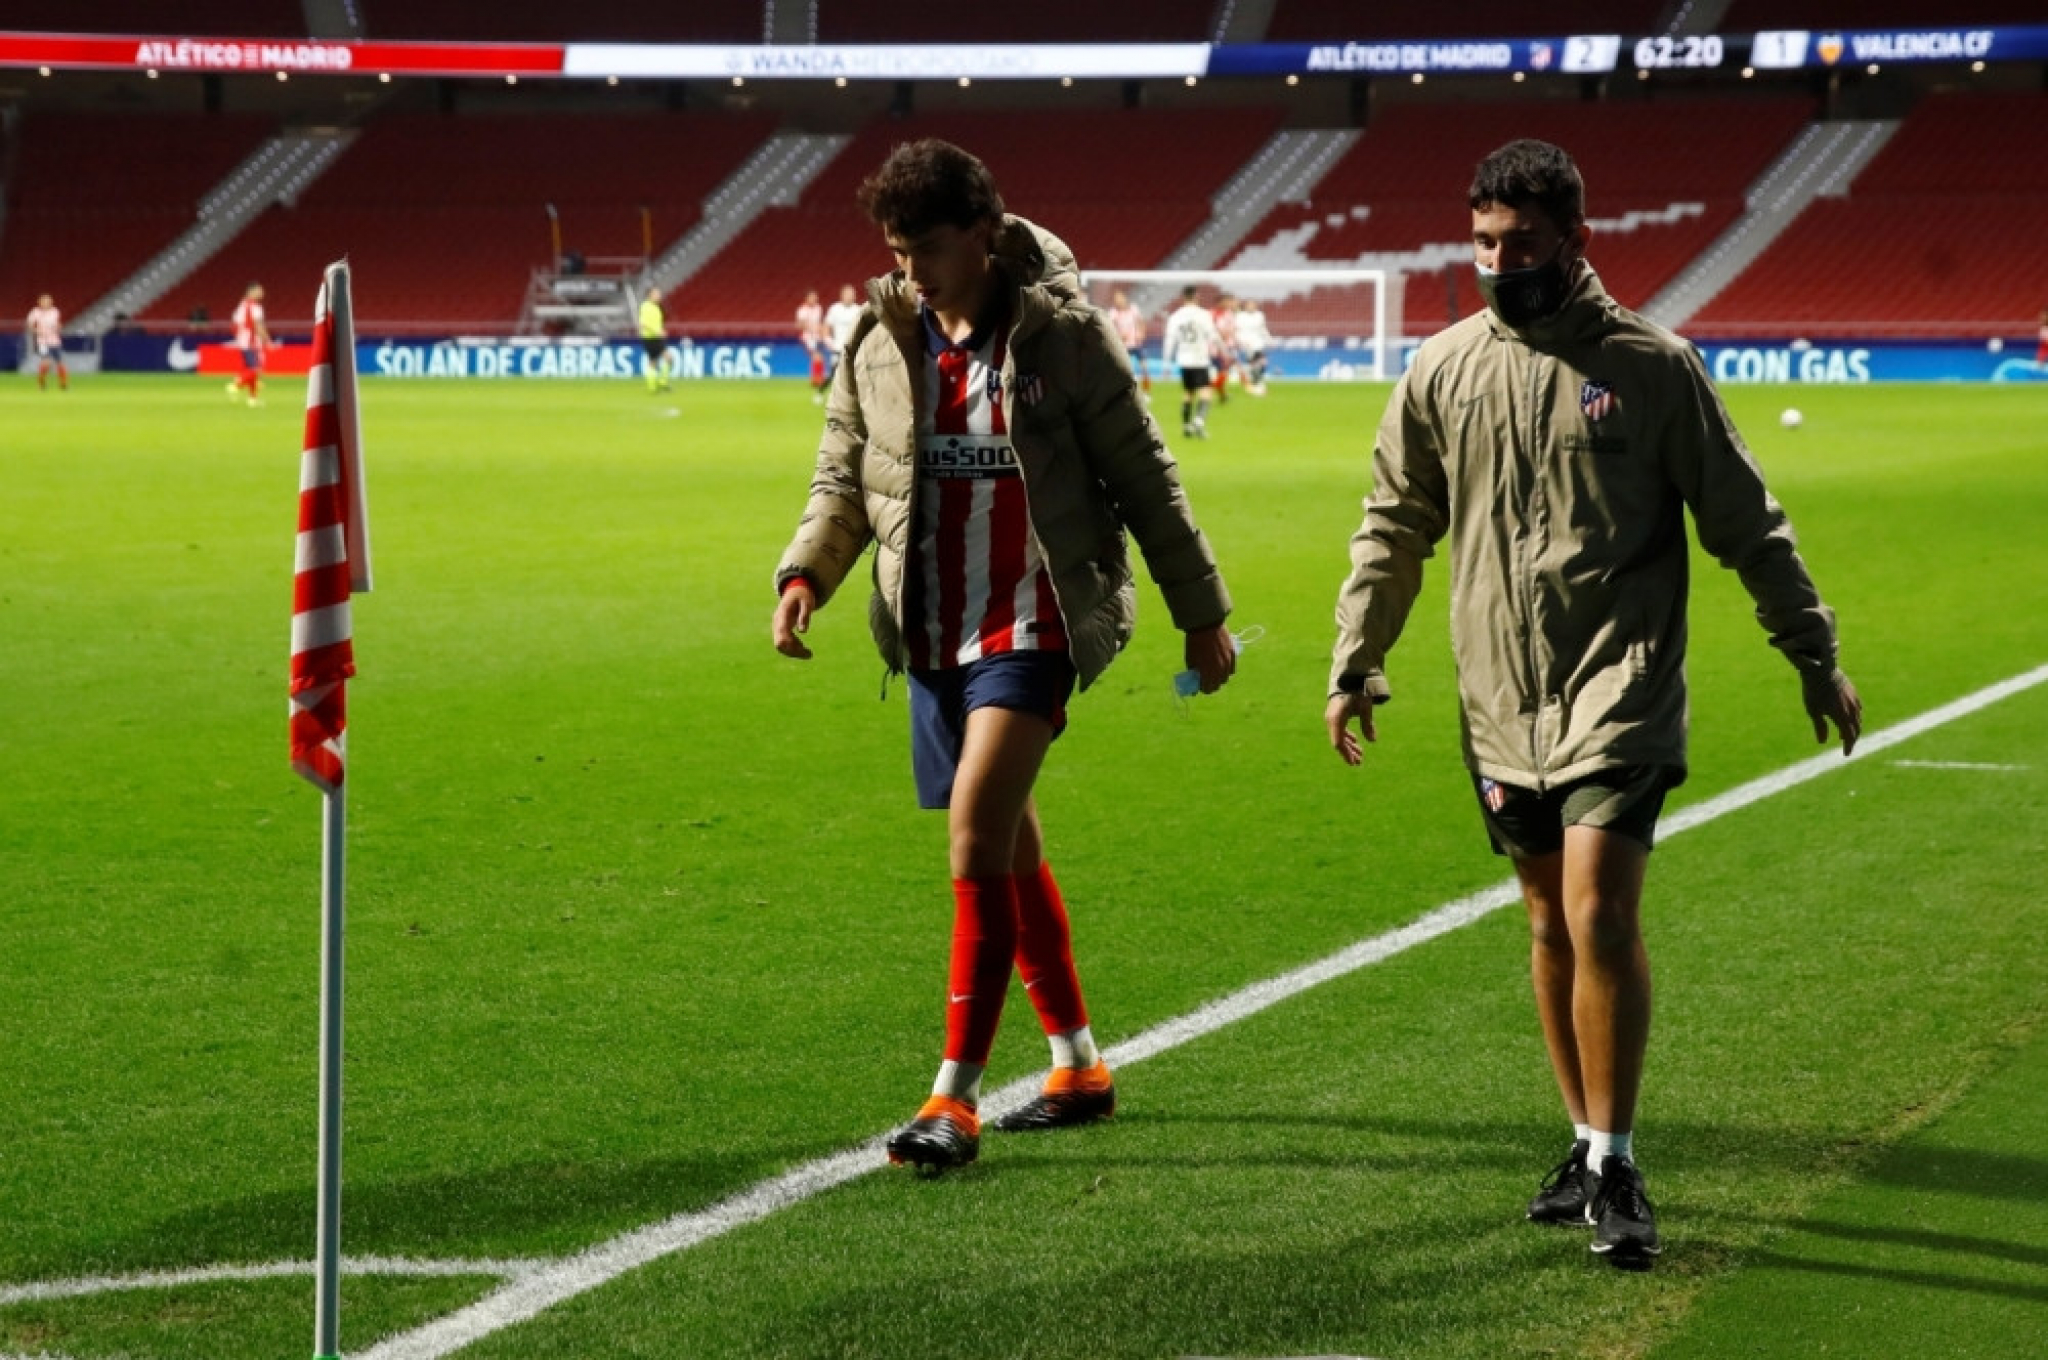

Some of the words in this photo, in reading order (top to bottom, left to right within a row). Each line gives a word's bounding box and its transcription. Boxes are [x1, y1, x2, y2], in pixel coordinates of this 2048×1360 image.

[135, 39, 242, 67] ATLÉTICO
[261, 44, 353, 70] MADRID
[1306, 41, 1399, 70] ATLÉTICO
[1401, 44, 1427, 70] DE
[1429, 43, 1512, 69] MADRID
[1633, 35, 1723, 68] 62:20
[1852, 32, 1962, 60] VALENCIA
[1964, 31, 1994, 57] CF
[753, 52, 845, 71] WANDA
[476, 345, 515, 378] DE
[520, 345, 633, 378] CABRAS
[712, 345, 771, 378] GAS
[1715, 348, 1791, 382] CON
[1799, 348, 1870, 382] GAS
